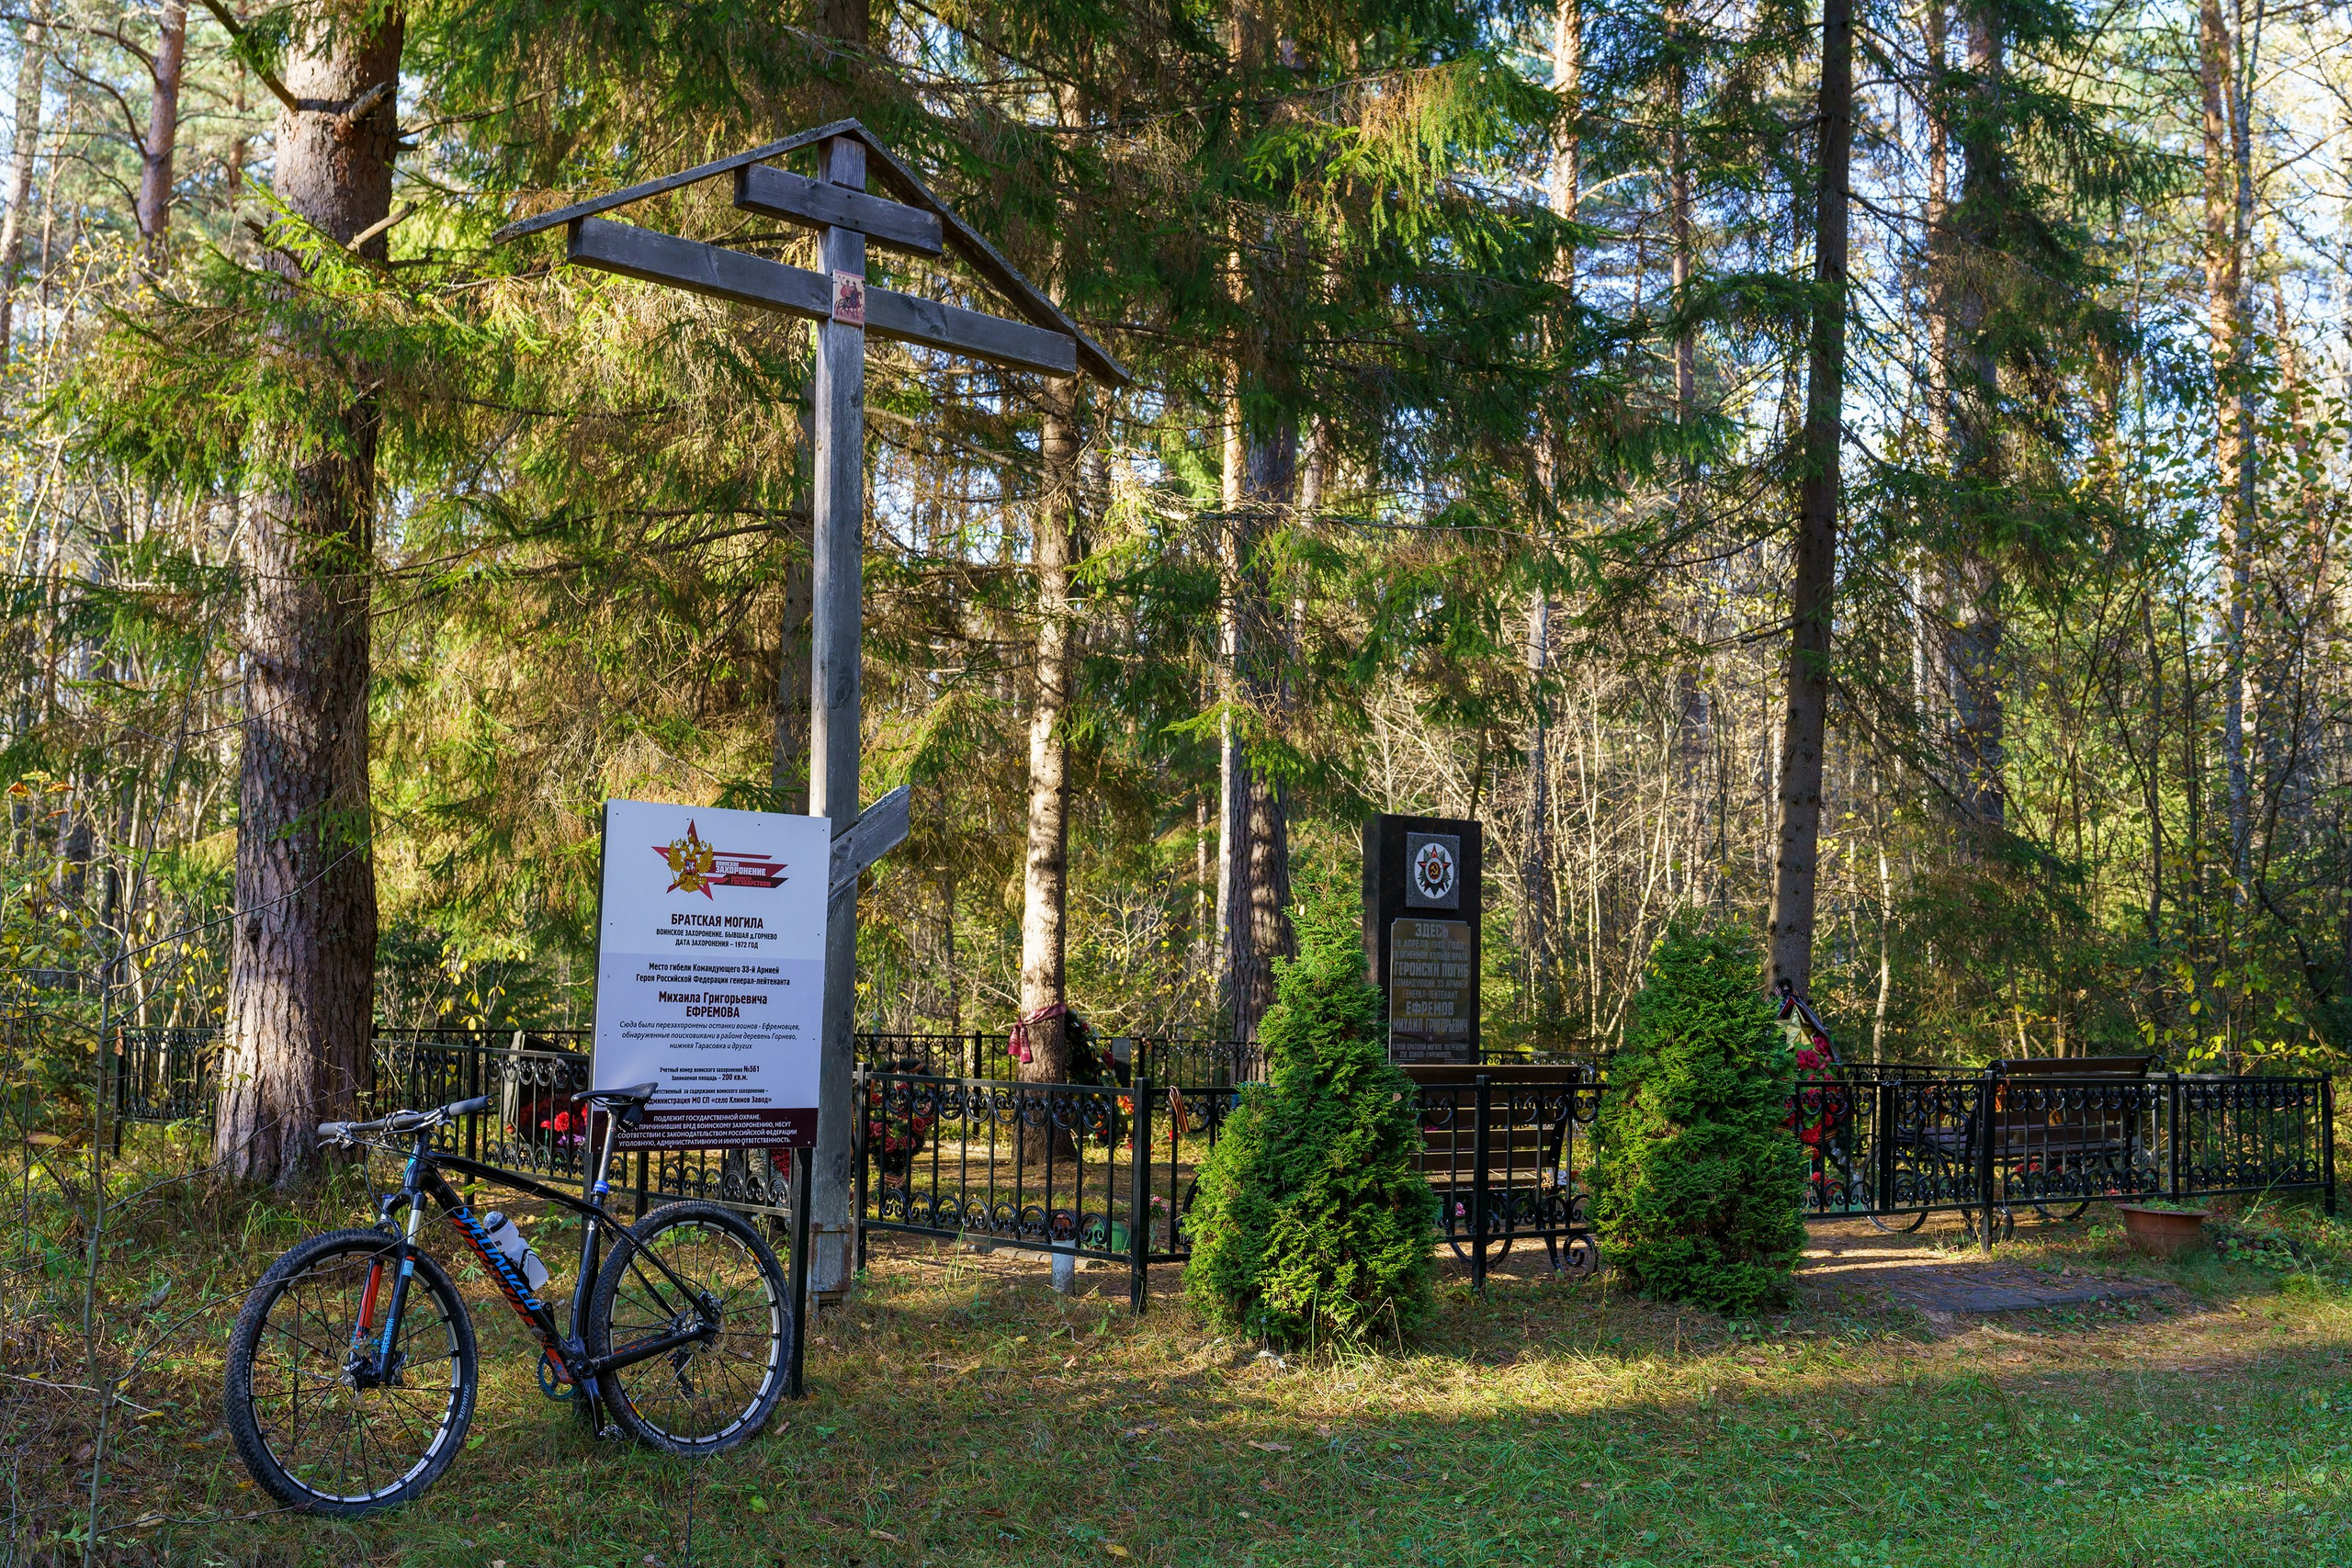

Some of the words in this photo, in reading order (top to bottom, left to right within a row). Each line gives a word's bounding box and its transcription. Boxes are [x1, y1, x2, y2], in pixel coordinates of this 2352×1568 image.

[716, 866, 766, 875] ЗАХОРОНЕНИЕ
[671, 914, 721, 927] БРАТСКАЯ
[724, 917, 763, 929] МОГИЛА
[750, 932, 777, 941] д.ГОРНЕВО
[1415, 923, 1448, 938] ЗДЕСЬ
[1394, 939, 1400, 947] 19
[1404, 939, 1429, 948] АПРЕЛЯ
[1394, 950, 1397, 959] В
[1399, 951, 1428, 960] ОГНЕННОМ
[1430, 952, 1451, 961] КОЛЬЦЕ
[1452, 953, 1468, 962] ВРАГА
[649, 963, 668, 971] Место
[670, 964, 690, 972] гибели
[693, 964, 741, 974] Командующего
[741, 964, 755, 973] 33-й
[756, 965, 779, 974] Армией
[1442, 963, 1468, 977] ПОГИБ
[636, 974, 655, 982] Героя
[656, 974, 692, 983] Российской
[693, 975, 729, 985] Федерации
[729, 976, 790, 986] генерал-лейтенанта
[1437, 979, 1444, 987] 33
[659, 991, 700, 1003] Михаила
[703, 992, 767, 1006] Григорьевича
[1402, 989, 1458, 999] ГЕНЕРАЛ-ЛЕЙТЕНАНТ
[685, 1006, 740, 1018] ЕФРЕМОВА
[1406, 1000, 1454, 1016] ЕФРЕМОВ
[762, 1022, 800, 1031] Ефремовцев,
[1393, 1018, 1423, 1032] МИХАИЛ
[1425, 1018, 1468, 1032] ГРИГОРЬЕВИЧ
[622, 1032, 670, 1040] обнаруженные
[720, 1032, 742, 1041] районе
[743, 1032, 770, 1041] деревень
[771, 1032, 797, 1041] Горнево,
[732, 1043, 752, 1051] других
[685, 1113, 738, 1122] ГОСУДАРСТВЕННОЙ
[453, 1207, 540, 1311] SPECIALIZED
[379, 1318, 394, 1353] ROCKSHOX
